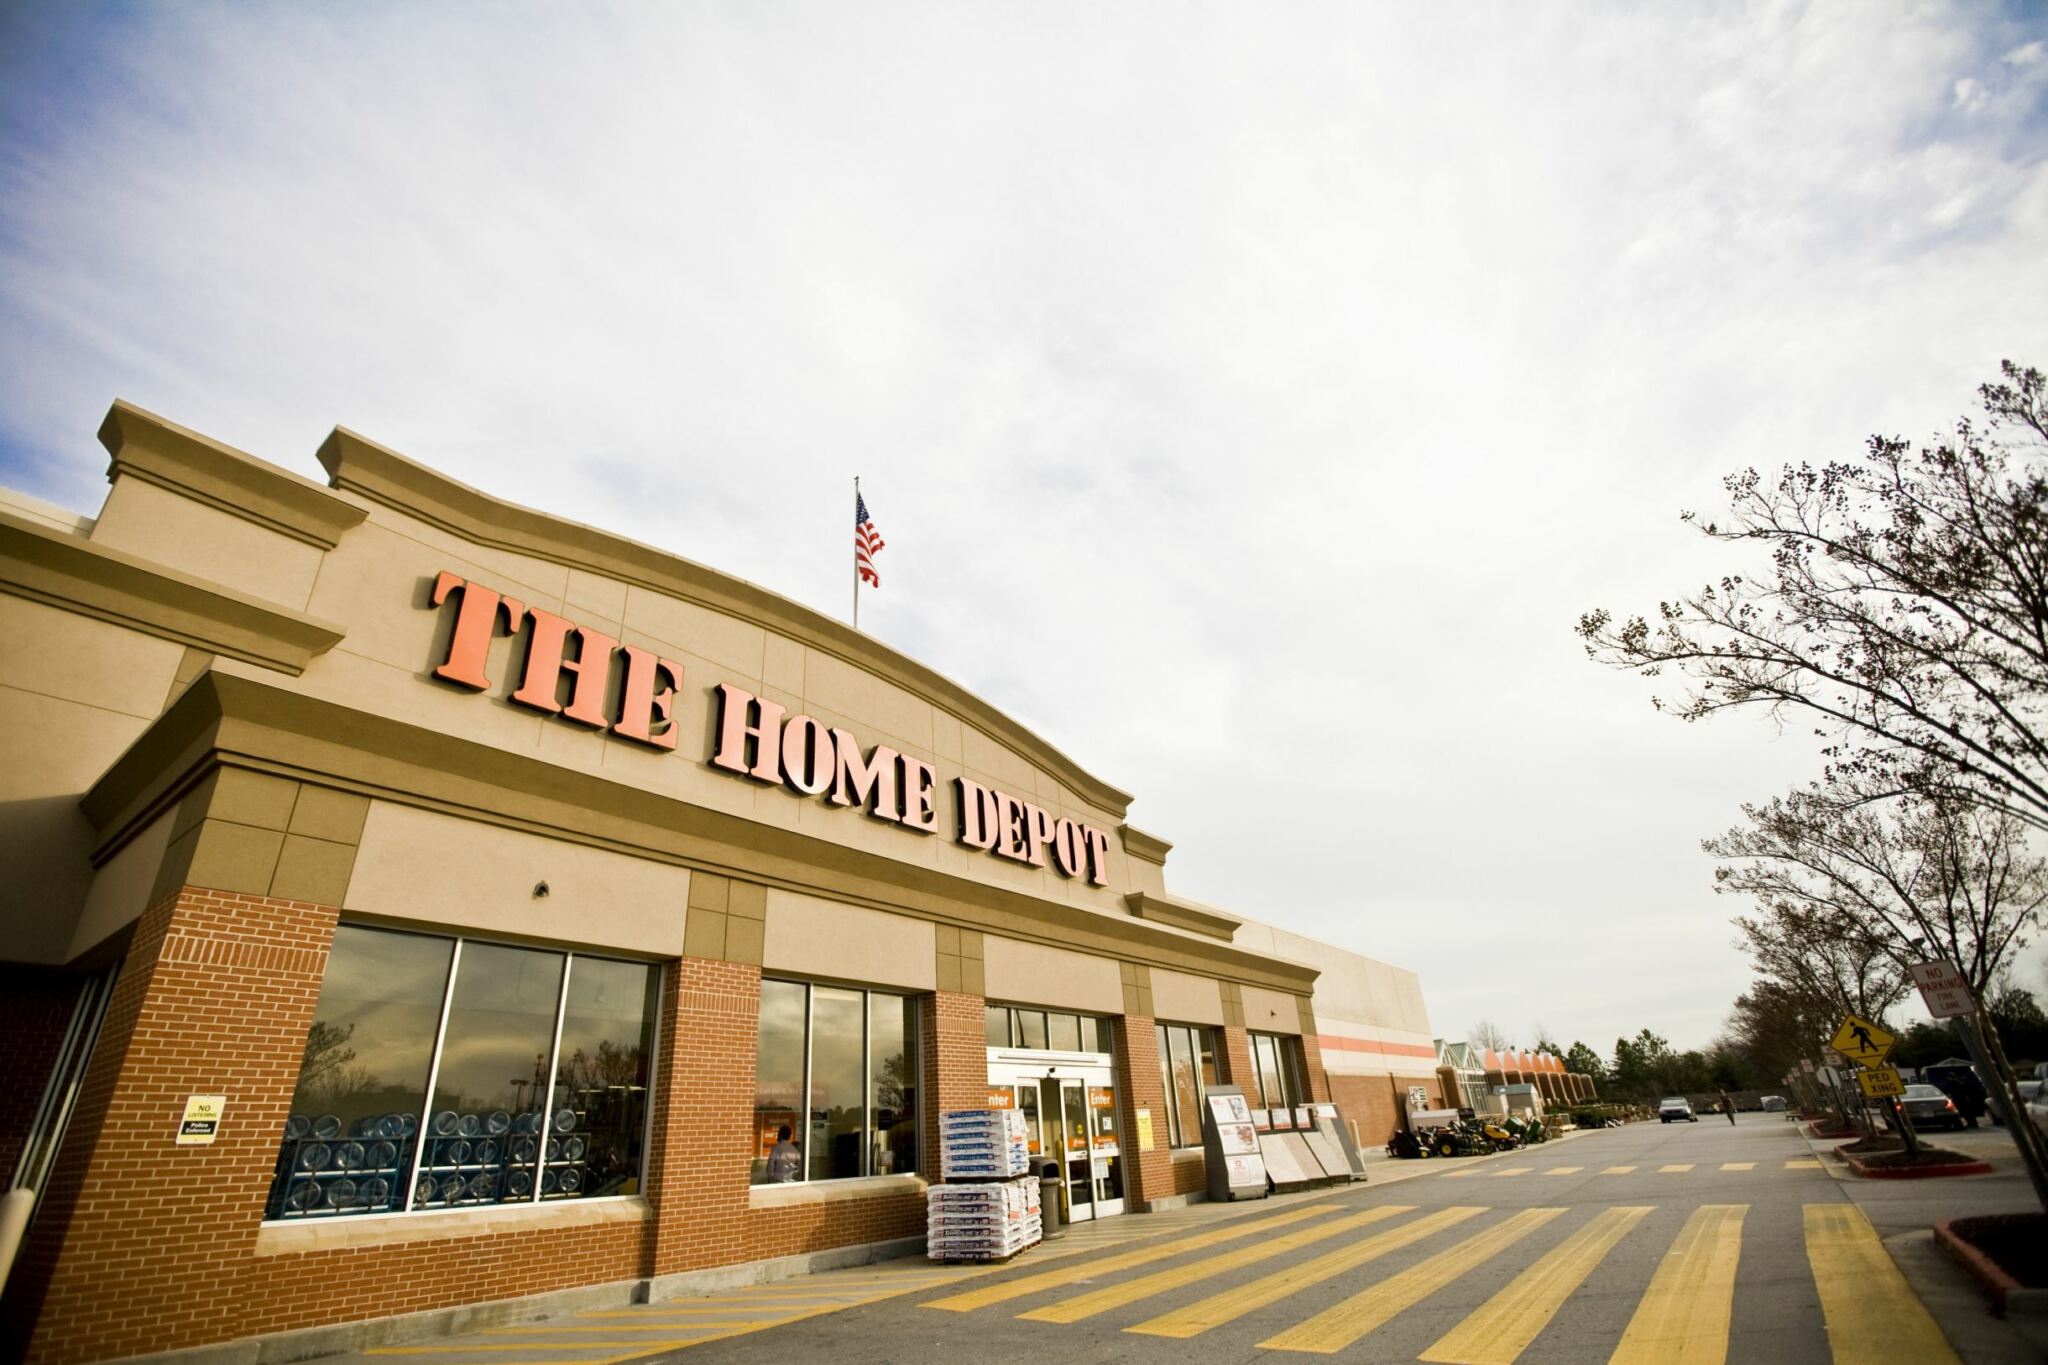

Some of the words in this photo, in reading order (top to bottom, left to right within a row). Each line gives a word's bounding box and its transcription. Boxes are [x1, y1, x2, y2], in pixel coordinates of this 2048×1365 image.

[430, 570, 685, 751] THE
[708, 682, 938, 834] HOME
[955, 776, 1111, 888] DEPOT
[1925, 967, 1943, 980] NO
[1920, 977, 1963, 993] PARKING
[1940, 1000, 1962, 1010] LANE
[1867, 1072, 1890, 1082] PED
[1871, 1082, 1898, 1094] XING
[988, 1093, 1009, 1106] nter
[1090, 1092, 1111, 1105] Enter
